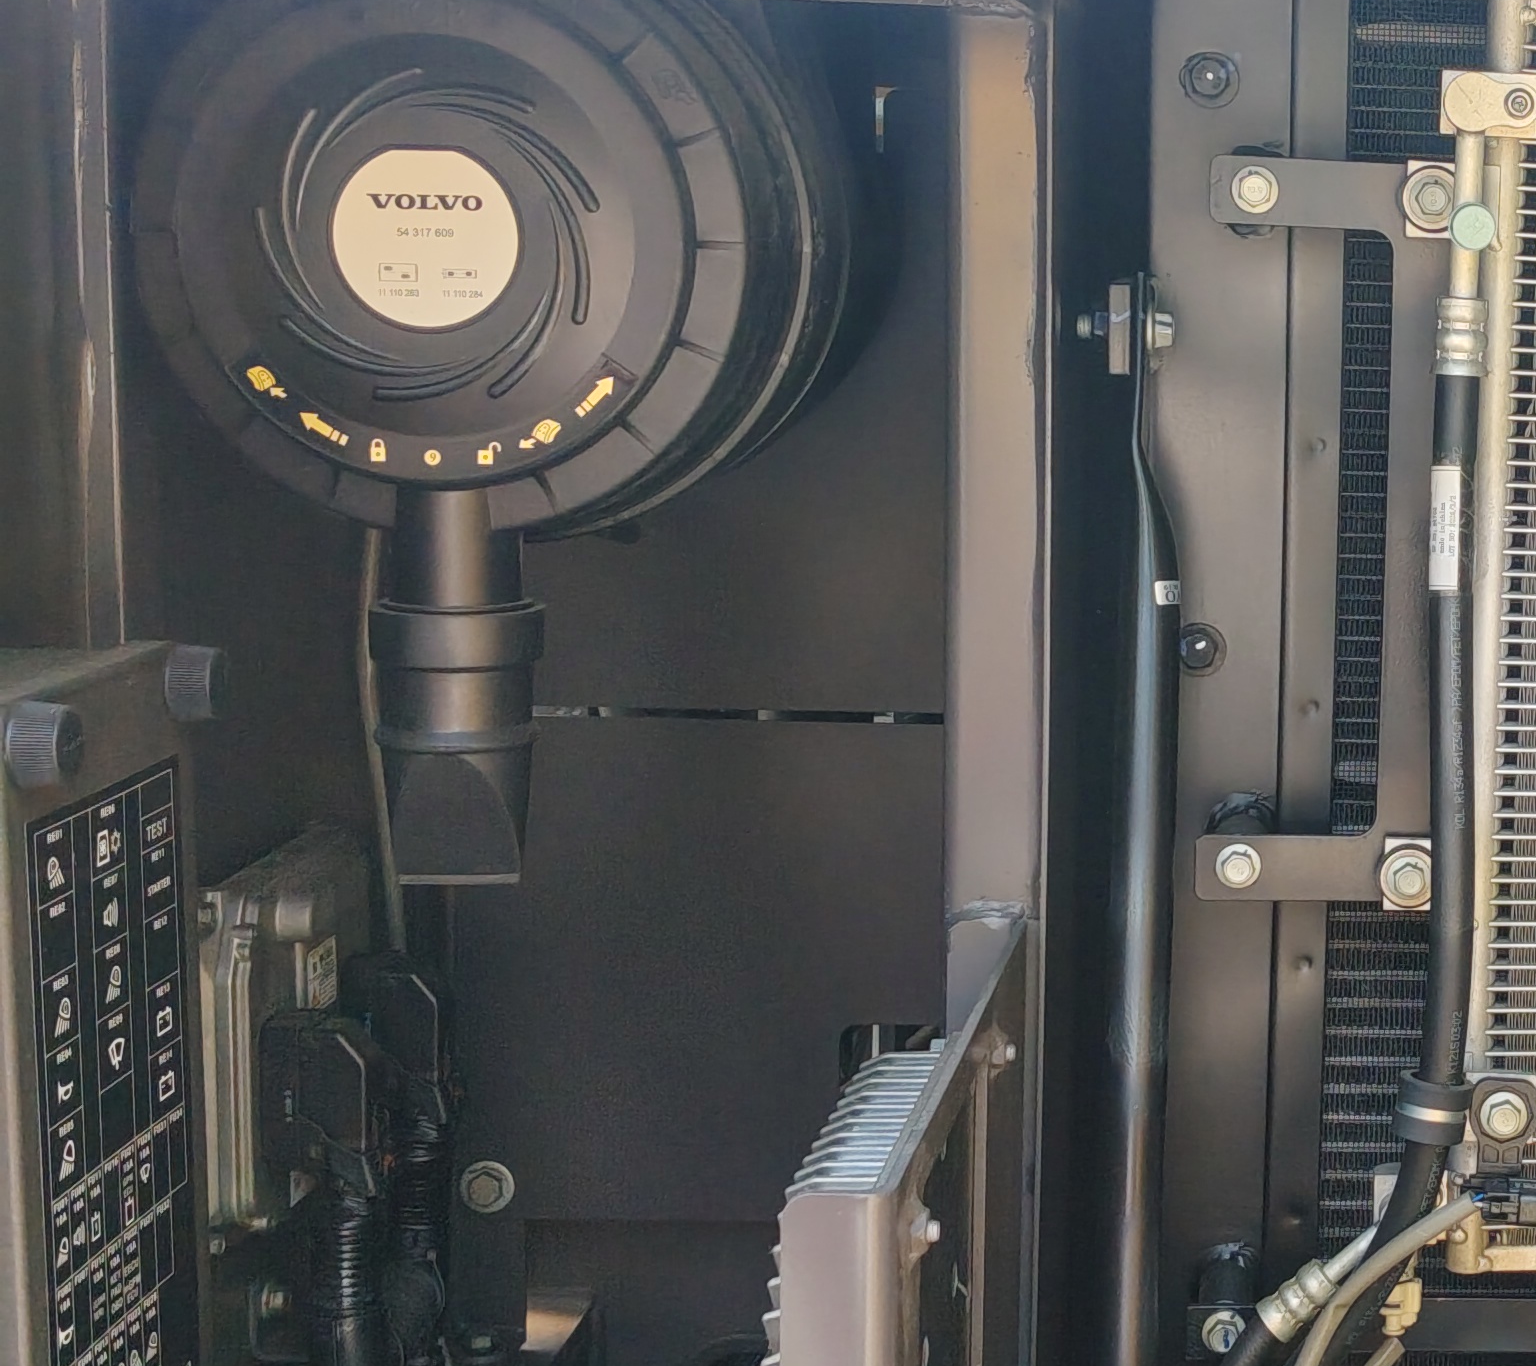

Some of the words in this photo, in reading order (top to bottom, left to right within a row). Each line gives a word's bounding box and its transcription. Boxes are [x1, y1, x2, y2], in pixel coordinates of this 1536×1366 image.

[366, 193, 483, 212] VOLVO
[396, 228, 409, 237] 54
[413, 228, 430, 238] 317
[435, 228, 454, 238] 609
[145, 816, 167, 843] TEST
